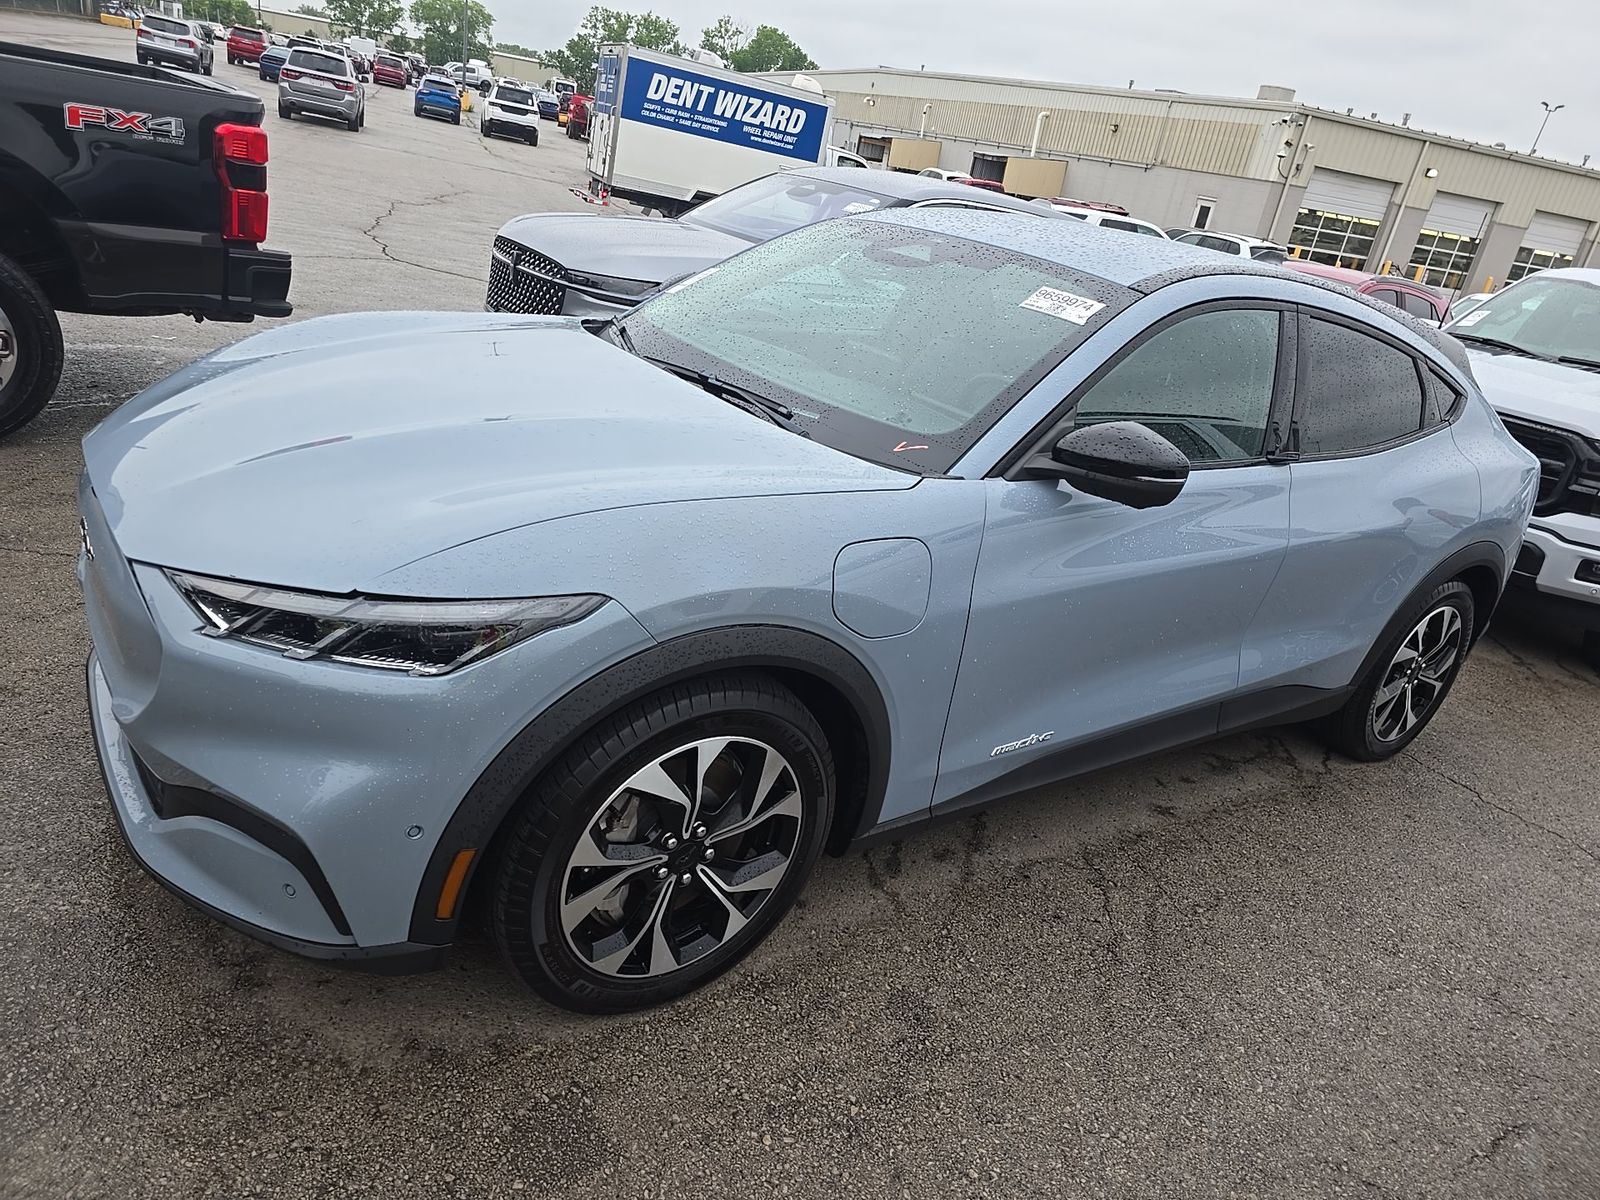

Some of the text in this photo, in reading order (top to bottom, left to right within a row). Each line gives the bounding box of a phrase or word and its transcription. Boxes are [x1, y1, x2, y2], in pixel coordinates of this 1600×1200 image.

[643, 102, 728, 128] SCUFFS CURB RASH STRAIGHTENING
[646, 72, 807, 135] DENT WIZARD
[63, 101, 186, 140] FX4
[641, 109, 720, 133] COLOR CHANGE SAME DAY SERVICE
[743, 125, 798, 144] WHEEL REPAIR UNIT
[1035, 289, 1094, 312] 9659974
